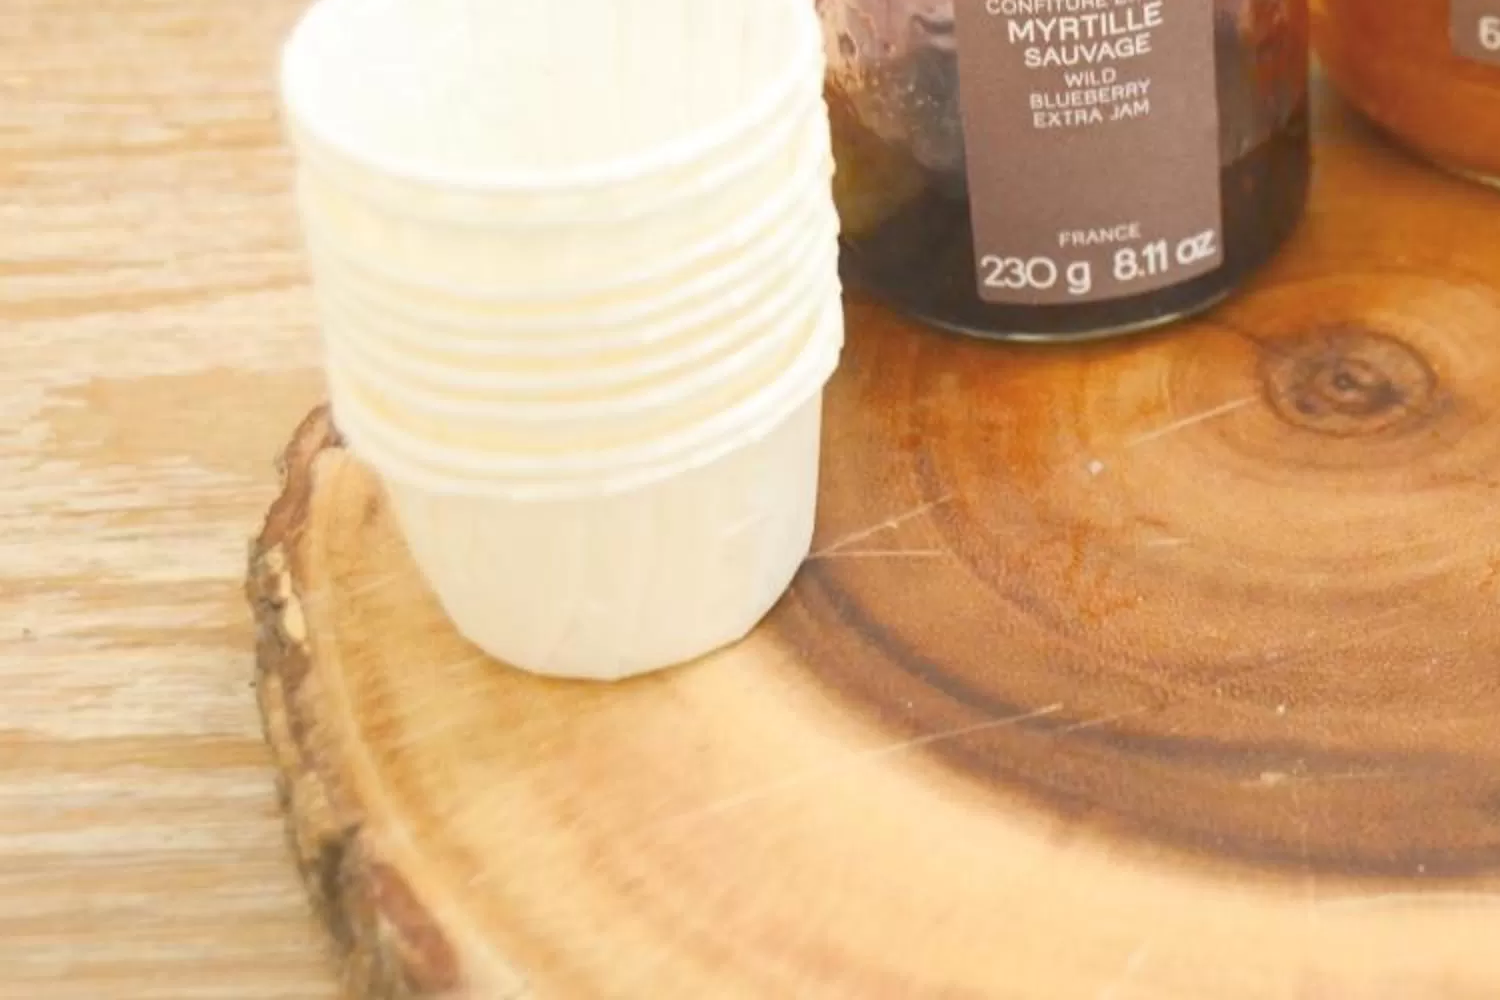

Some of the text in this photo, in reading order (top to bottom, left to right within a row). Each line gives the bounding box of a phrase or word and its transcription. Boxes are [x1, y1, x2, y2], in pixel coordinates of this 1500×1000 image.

[1007, 0, 1164, 45] MYRTILLE
[1024, 32, 1153, 69] SAUVAGE
[1063, 66, 1118, 89] WILD
[1029, 78, 1151, 110] BLUEBERRY
[1033, 98, 1151, 129] EXTRA JAM
[1058, 220, 1142, 249] FRANCE
